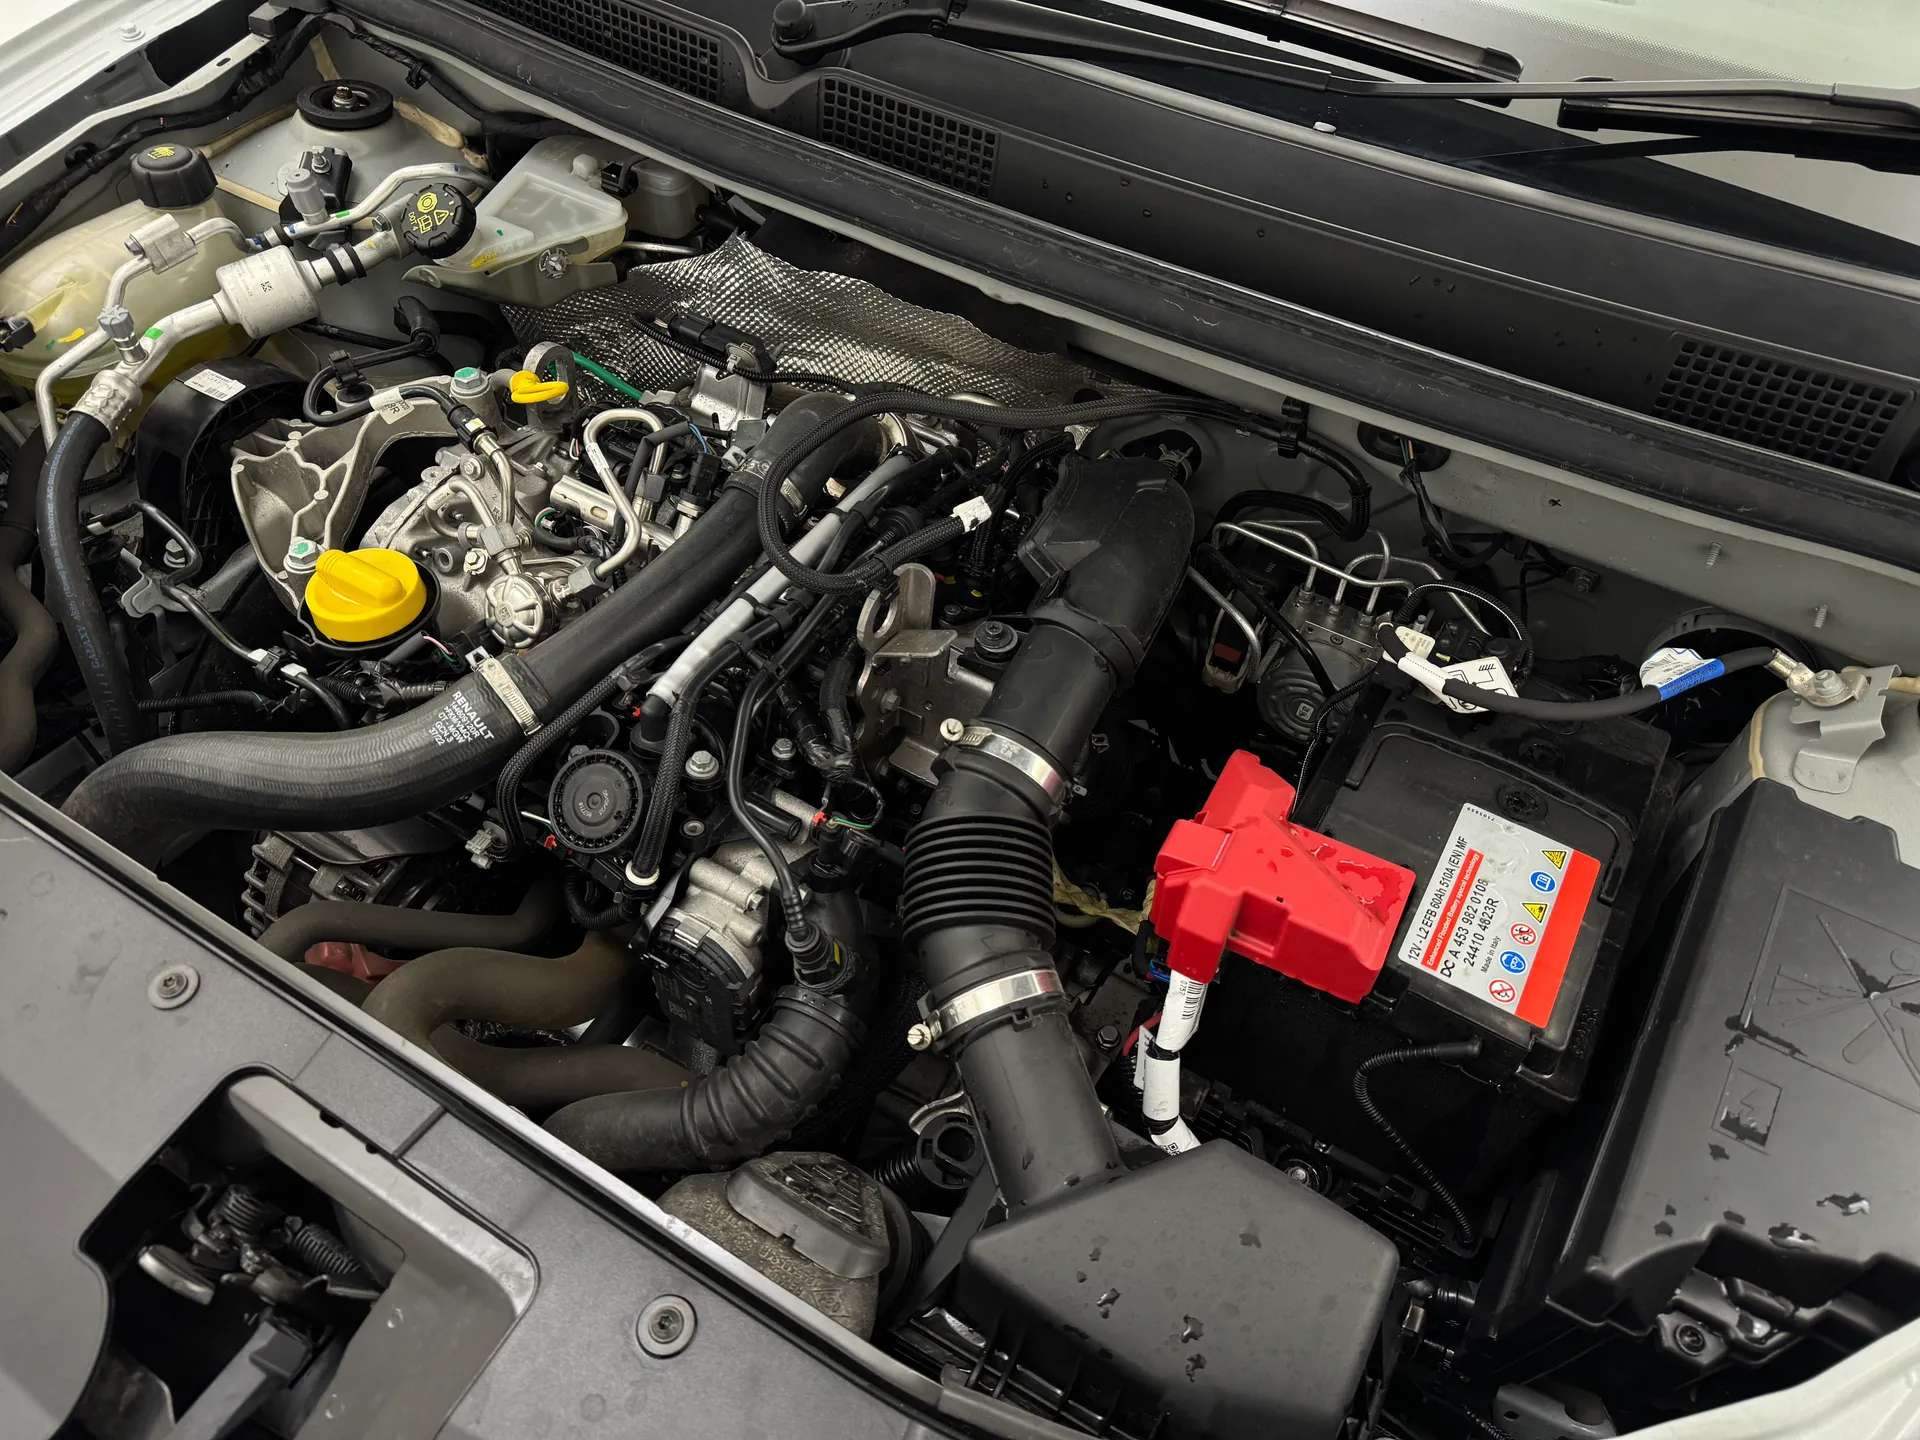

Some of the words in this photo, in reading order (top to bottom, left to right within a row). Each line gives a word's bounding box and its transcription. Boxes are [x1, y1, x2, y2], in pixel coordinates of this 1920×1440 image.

[408, 211, 417, 225] DOT
[452, 690, 495, 739] RENAULT
[1455, 835, 1468, 850] MF
[1448, 849, 1465, 869] (EN)
[1439, 867, 1456, 888] 510A
[1430, 888, 1447, 909] 60Ah
[1447, 898, 1460, 918] Battery
[1422, 908, 1437, 928] EFB
[1461, 905, 1478, 926] 982
[1416, 926, 1430, 940] L2
[1454, 926, 1469, 947] 453
[1408, 943, 1422, 960] 12V
[1449, 949, 1460, 960] A
[1463, 933, 1485, 967] 24410
[1480, 957, 1490, 974] Made
[1490, 935, 1502, 951] Italy
